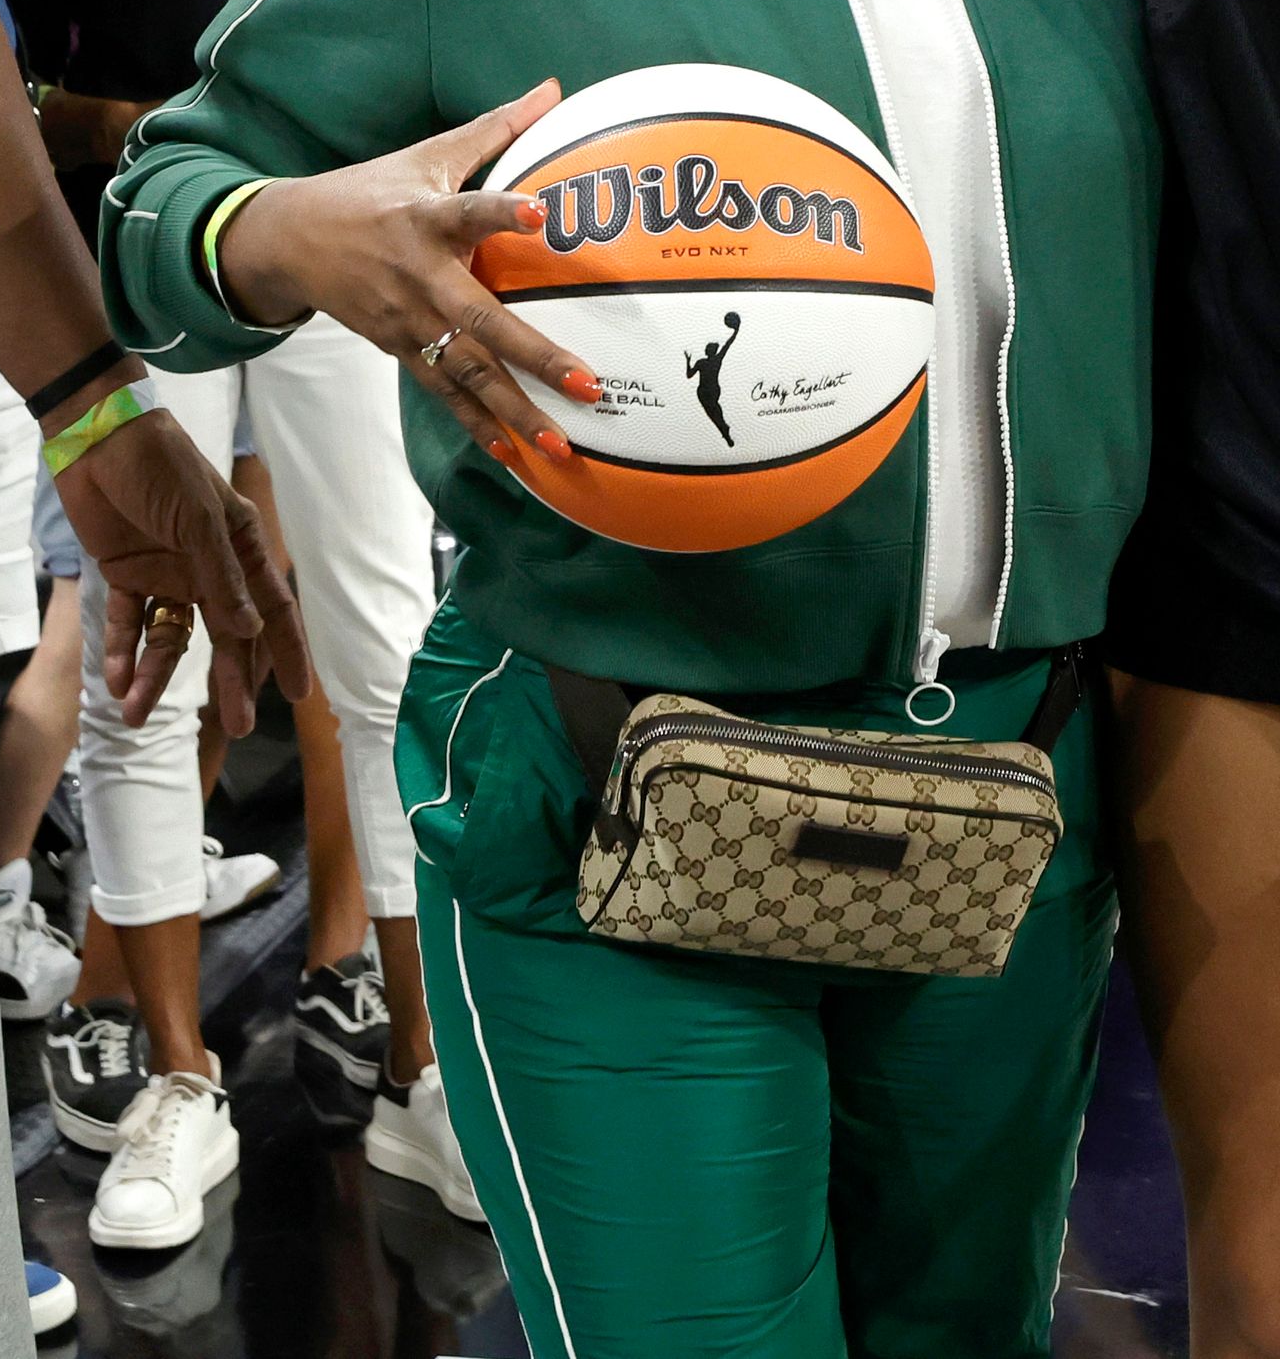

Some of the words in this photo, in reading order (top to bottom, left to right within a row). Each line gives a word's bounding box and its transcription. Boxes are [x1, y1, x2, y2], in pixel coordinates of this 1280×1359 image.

[536, 153, 865, 255] Wilson
[661, 247, 700, 258] EVO
[710, 246, 748, 257] NXT
[596, 377, 652, 392] FICIAL
[617, 394, 665, 407] BALL
